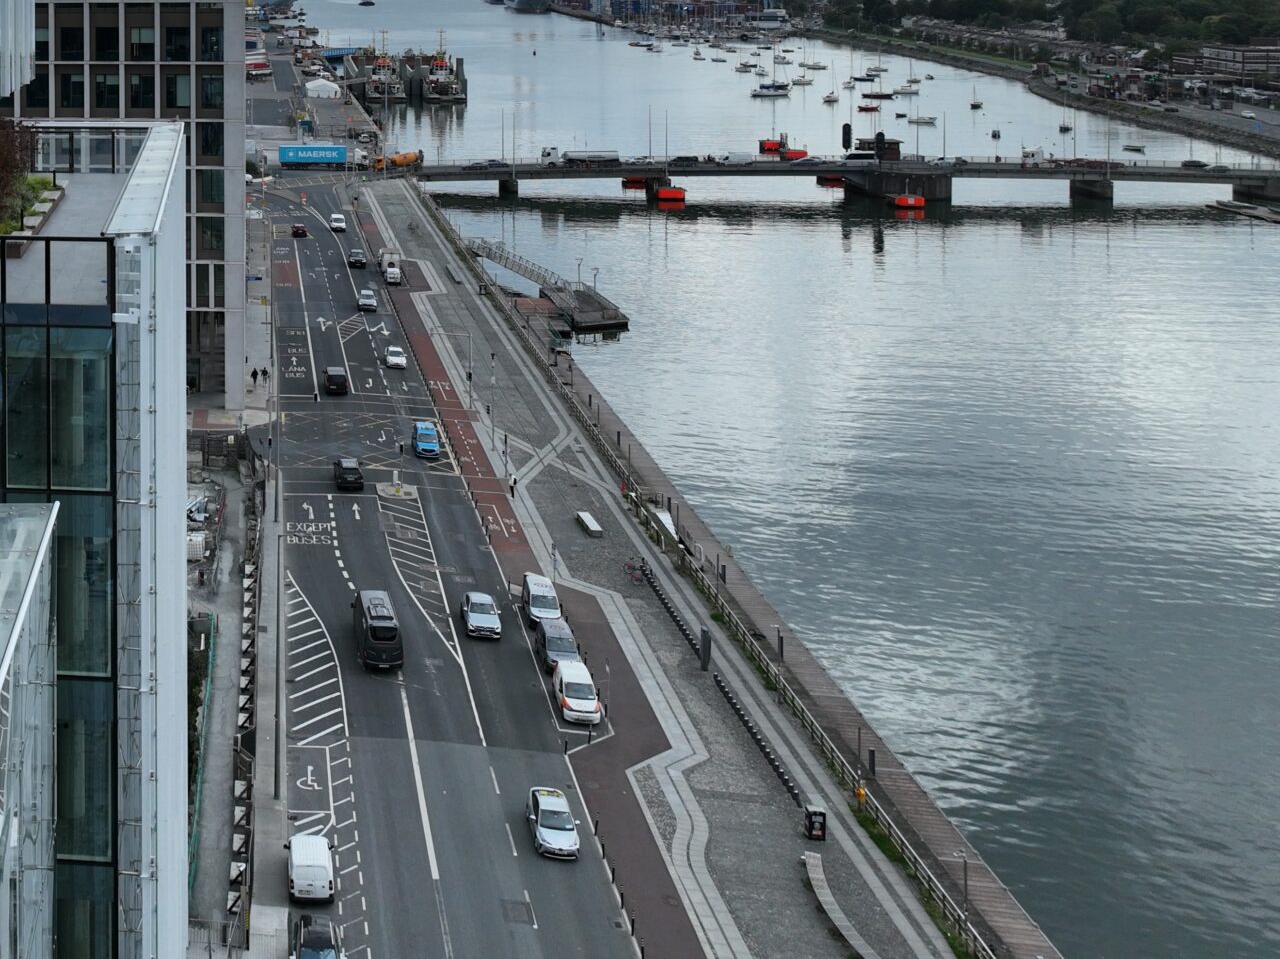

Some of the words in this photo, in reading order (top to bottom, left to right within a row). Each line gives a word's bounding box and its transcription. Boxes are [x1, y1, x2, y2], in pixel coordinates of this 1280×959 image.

[298, 150, 338, 158] MAERSK
[286, 522, 331, 532] EXCEPT
[286, 535, 331, 544] BUSES
